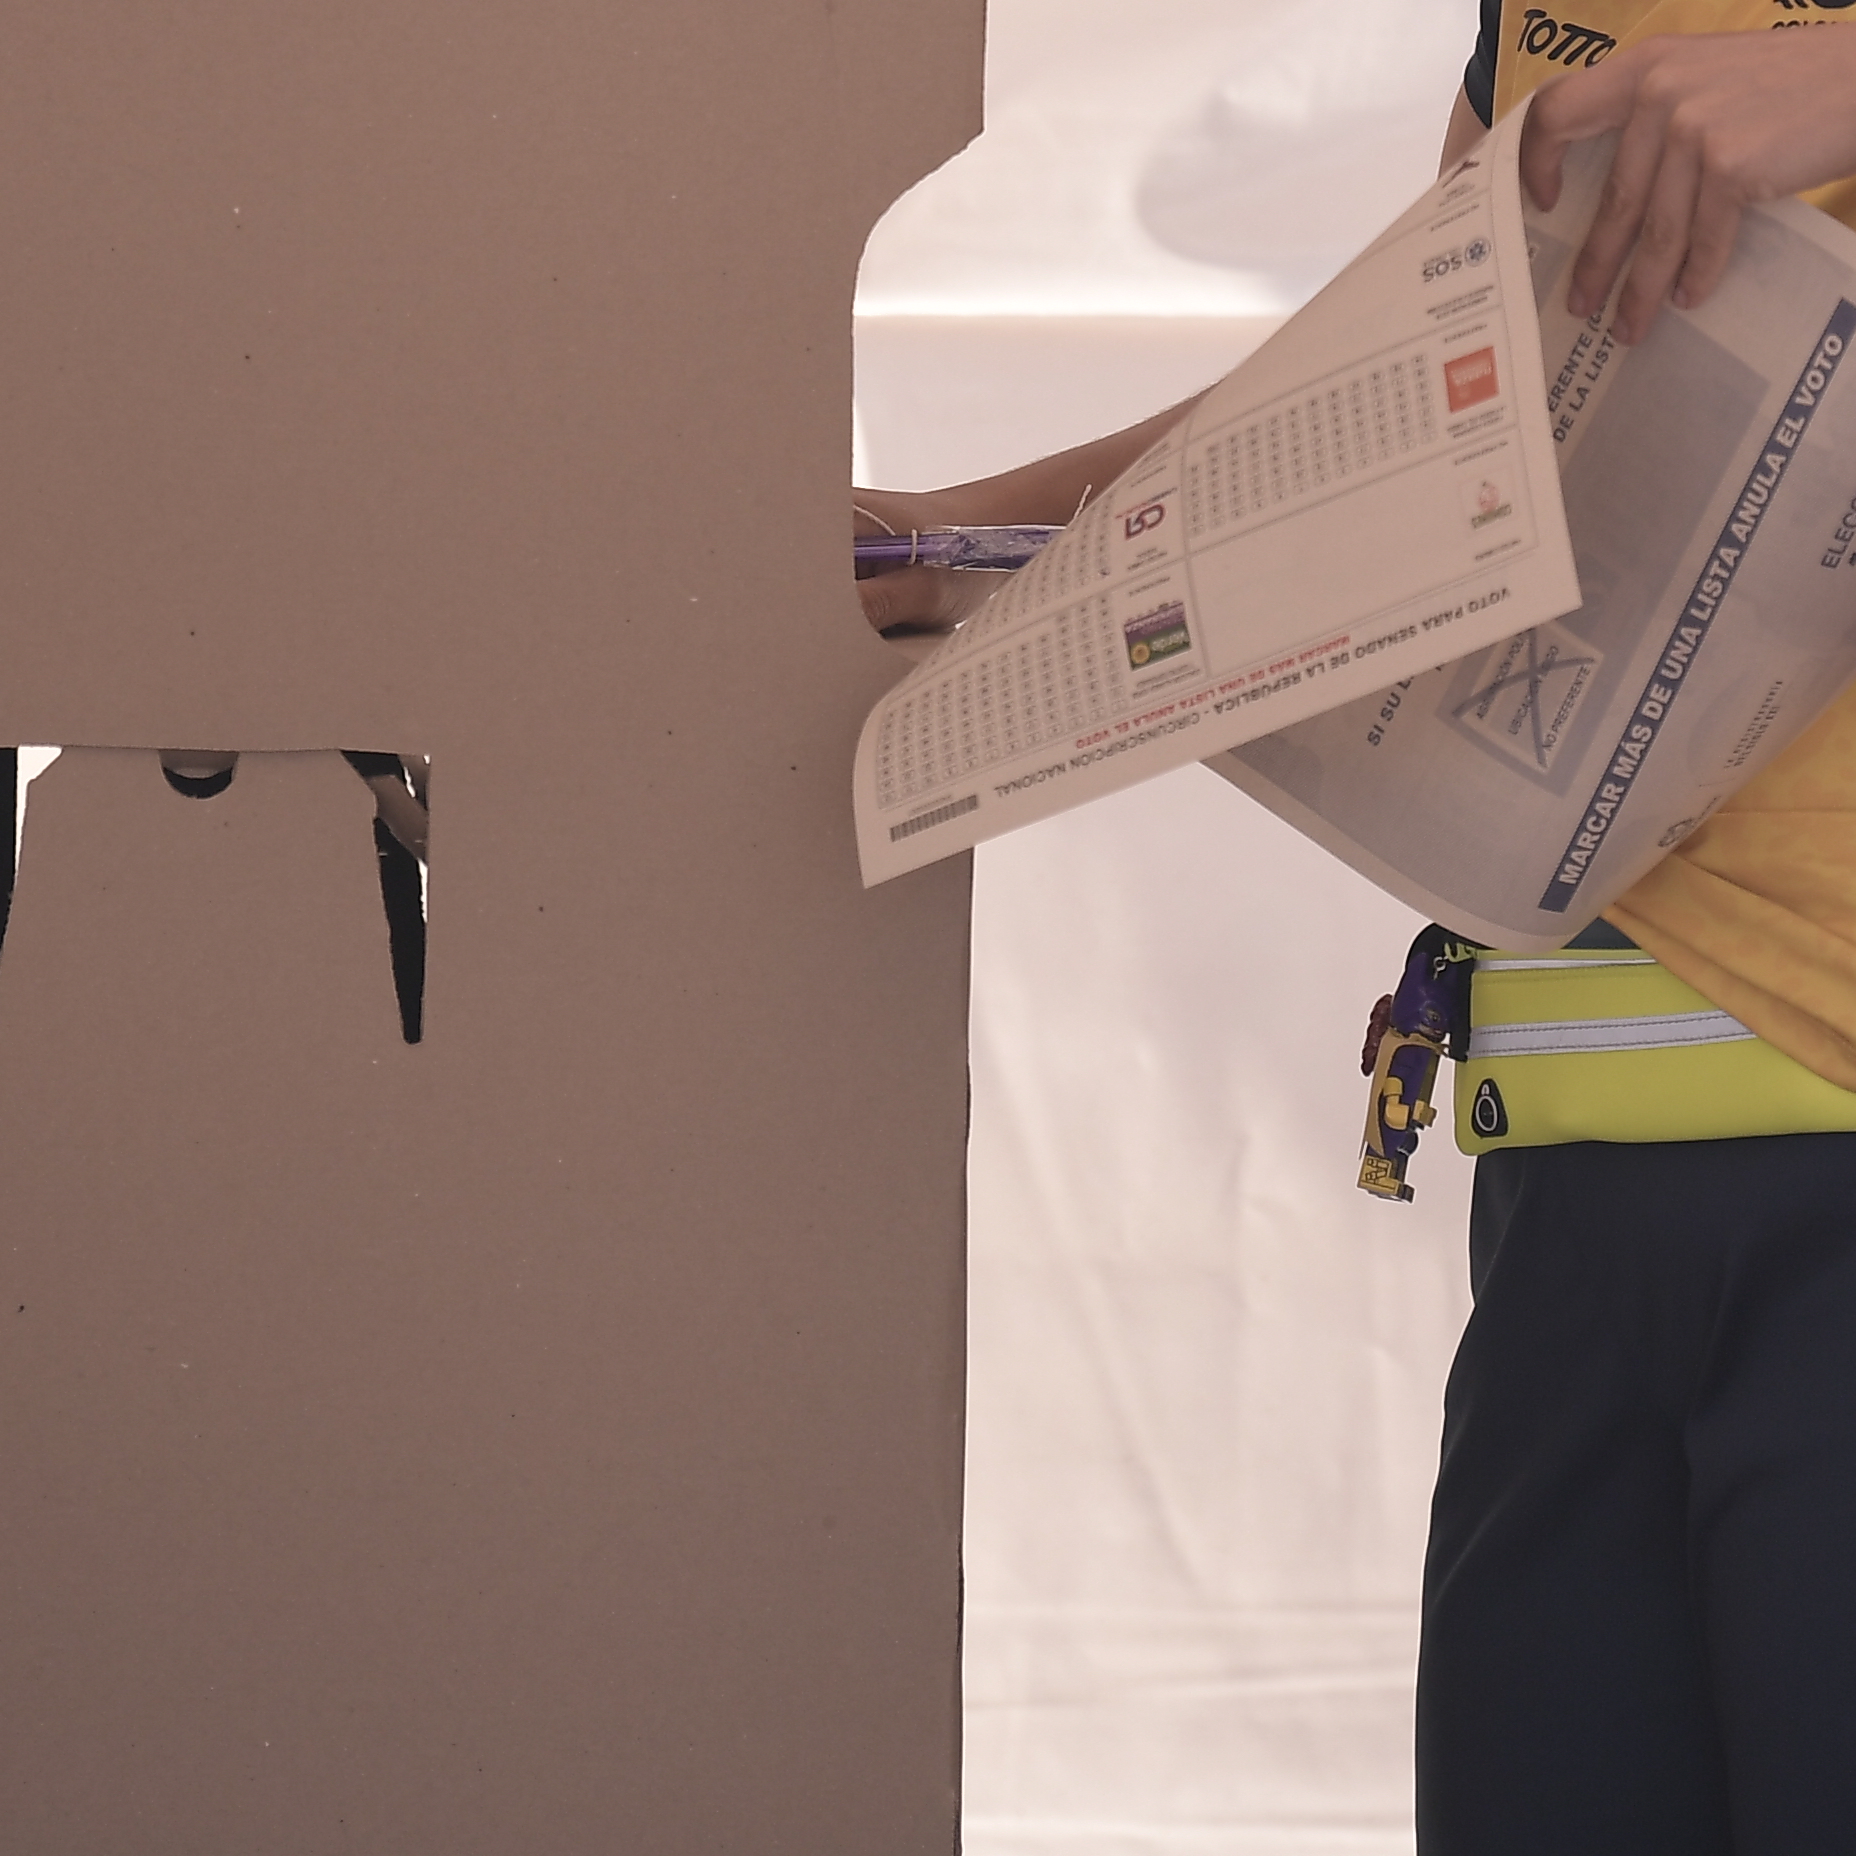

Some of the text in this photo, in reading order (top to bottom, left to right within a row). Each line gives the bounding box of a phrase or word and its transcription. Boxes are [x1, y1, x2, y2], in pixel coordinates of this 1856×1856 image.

[1517, 9, 1617, 69] TOTTO
[1420, 255, 1463, 283] SOS
[1543, 332, 1593, 413] ERENTE
[1551, 413, 1575, 443] DE
[1567, 383, 1591, 413] LA
[1584, 327, 1620, 382] LIST
[1421, 606, 1465, 632] PARA
[1466, 587, 1510, 614] VOTO
[1558, 331, 1846, 885] MARCAR MÁS DE UNA LISTA ANULA EL VOTO
[1328, 651, 1352, 669] DE
[1353, 624, 1419, 659] SENADO
[1305, 661, 1326, 678] LA
[1365, 691, 1402, 747] SI SU
[1549, 665, 1591, 733] PREFERENTE
